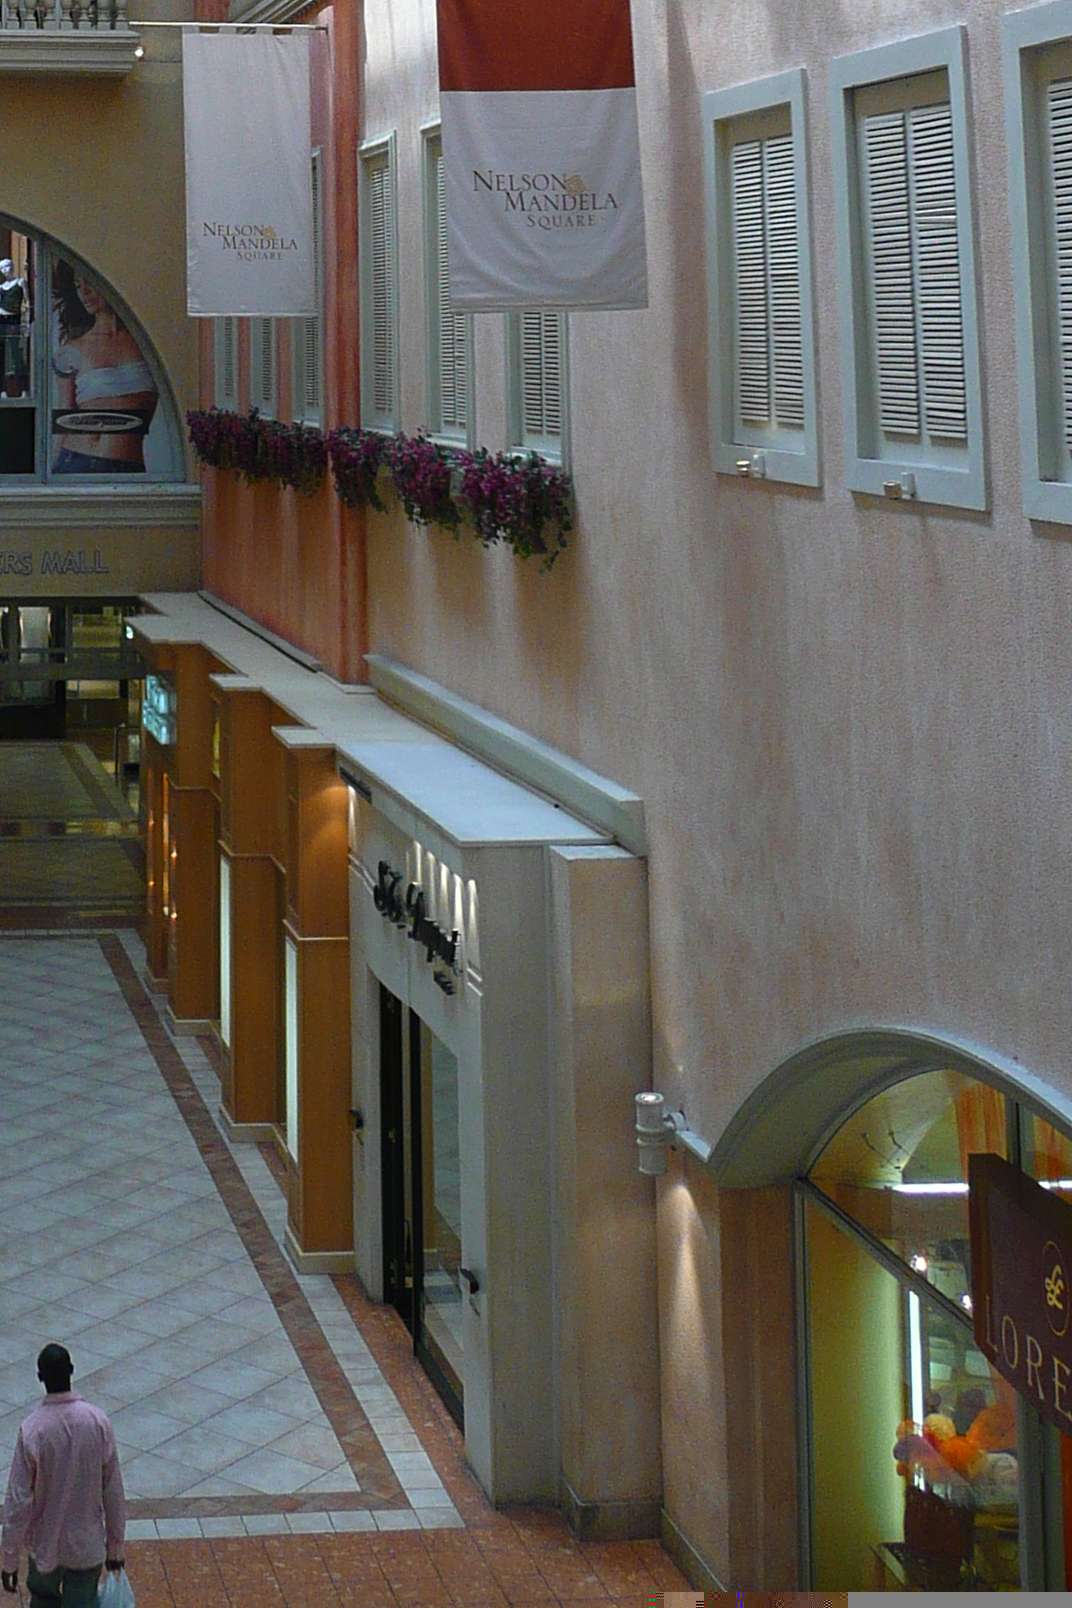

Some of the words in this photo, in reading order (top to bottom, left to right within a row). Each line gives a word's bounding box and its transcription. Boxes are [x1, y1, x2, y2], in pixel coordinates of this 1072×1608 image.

[472, 170, 567, 192] NELSON
[504, 190, 619, 212] MANDELA
[203, 221, 265, 237] NELSON
[527, 213, 596, 231] SQUARE
[222, 234, 298, 250] MANDELA
[236, 252, 284, 262] SQUARE
[40, 551, 109, 575] MALL
